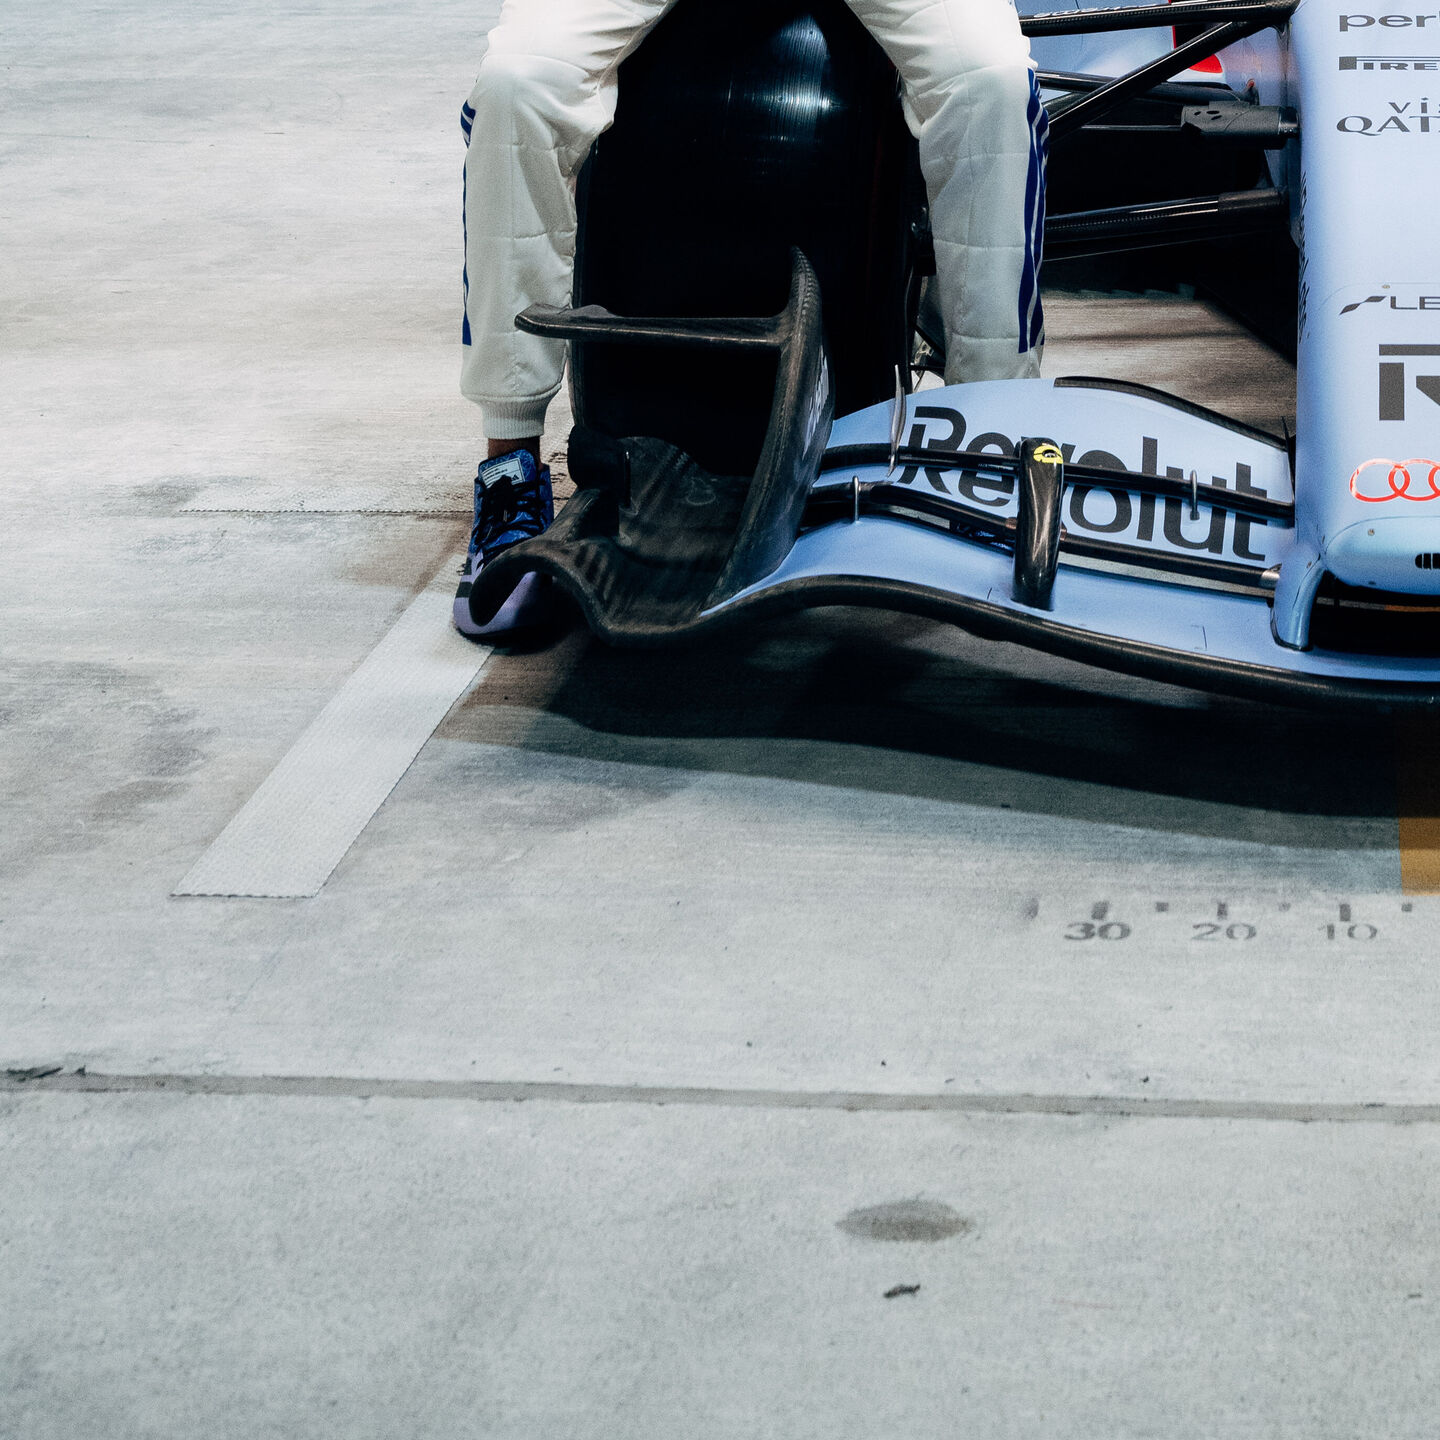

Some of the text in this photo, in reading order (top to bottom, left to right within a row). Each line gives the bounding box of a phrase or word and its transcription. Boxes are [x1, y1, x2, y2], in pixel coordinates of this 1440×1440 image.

[901, 406, 1268, 561] Reolut
[1064, 922, 1131, 941] 30
[1191, 923, 1257, 941] 20
[1318, 923, 1378, 941] 10
